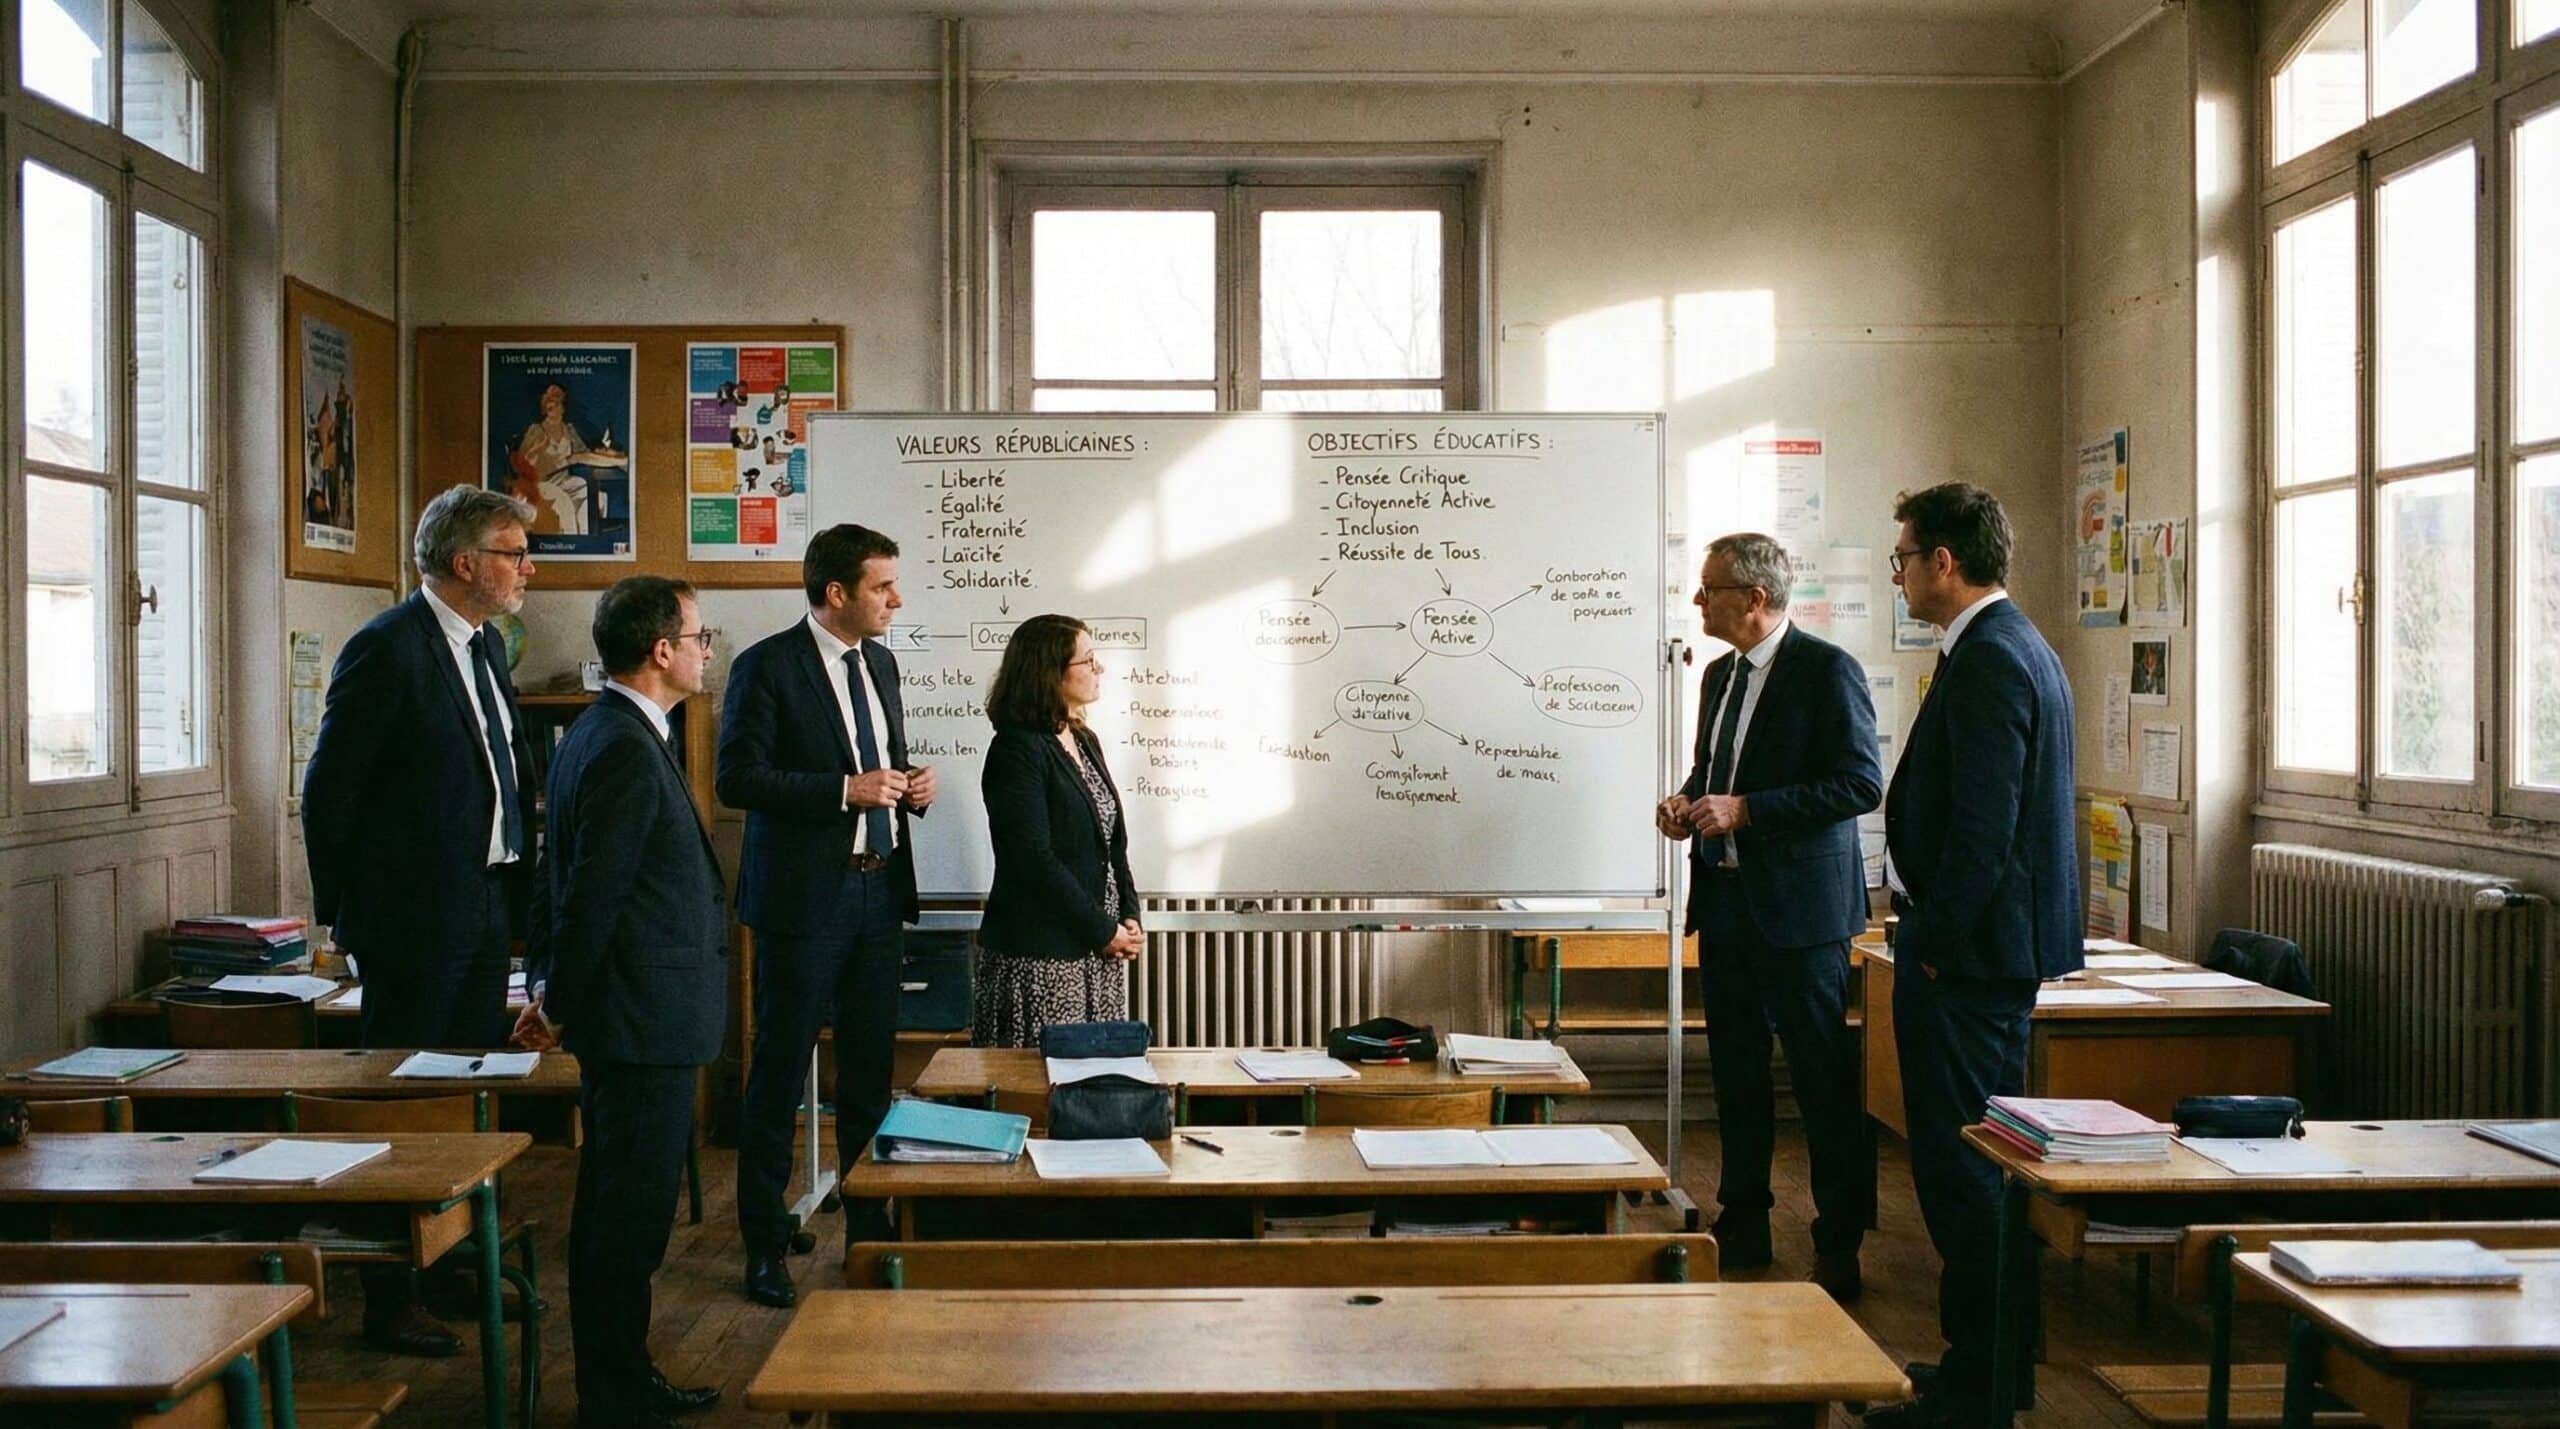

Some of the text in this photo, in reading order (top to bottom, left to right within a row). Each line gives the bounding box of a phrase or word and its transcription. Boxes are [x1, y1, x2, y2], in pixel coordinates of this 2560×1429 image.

[897, 435, 982, 455] VALEURS
[1308, 428, 1418, 451] OBJECTIFS
[1433, 427, 1541, 450] ÉDUCATIFS
[941, 468, 1006, 489] Liberté
[1336, 465, 1470, 493] Pensée Critique
[941, 492, 1005, 520] Égalité
[1336, 489, 1497, 517] Citoyenneté Active
[941, 518, 1027, 539] Fraternité
[1336, 516, 1420, 537] Inclusion
[942, 544, 1005, 564] Laïcité
[1338, 542, 1406, 561] Réussite
[1413, 543, 1434, 560] de
[1550, 588, 1568, 601] de
[1430, 628, 1477, 645] Active
[1544, 698, 1561, 711] de
[1496, 764, 1516, 778] de
